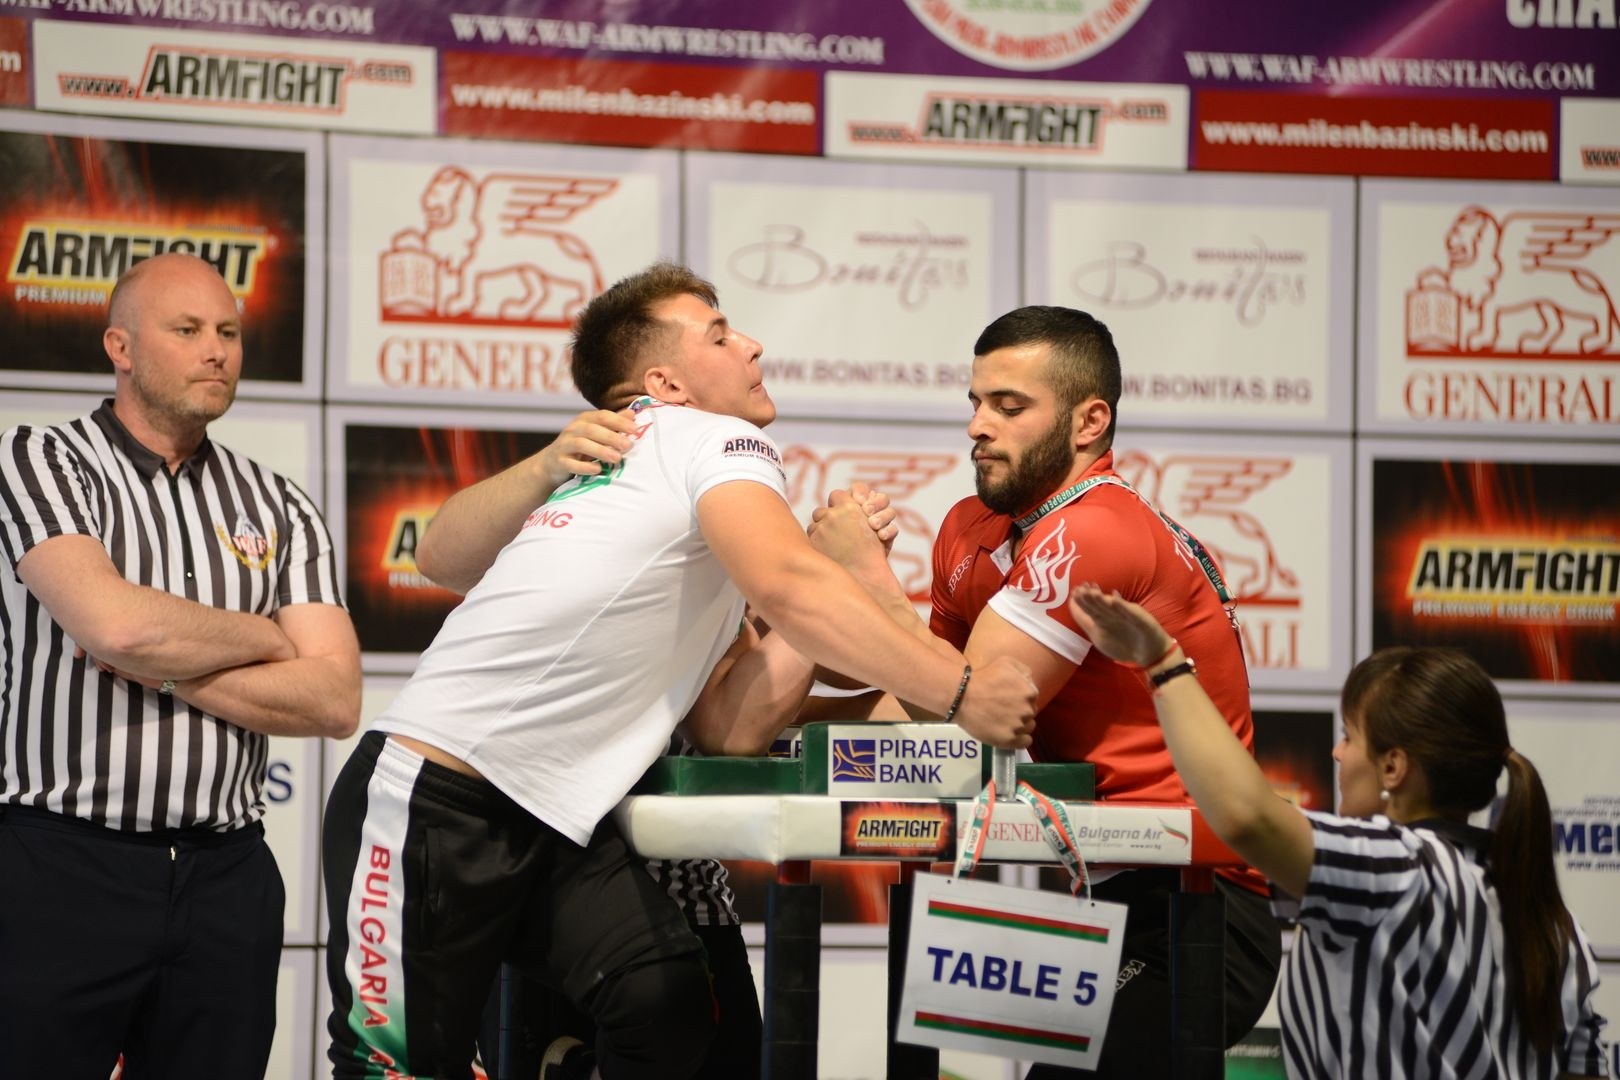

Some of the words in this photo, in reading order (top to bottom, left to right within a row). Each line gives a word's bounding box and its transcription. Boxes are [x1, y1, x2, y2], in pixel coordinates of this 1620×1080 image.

[451, 84, 815, 124] www.milenbazinski.com
[1202, 119, 1548, 153] www.milenbazinski.com
[15, 285, 106, 305] PREMIUM
[1416, 550, 1620, 592] ARMFIGHT
[879, 739, 978, 759] PIRAEUS
[879, 764, 943, 783] BANK
[857, 819, 942, 838] ARMFIGHT
[1079, 826, 1141, 842] Bulgaria
[1143, 828, 1163, 841] Air
[359, 844, 391, 1028] BULGARIA
[927, 946, 1062, 1001] TABLE
[1073, 970, 1099, 1007] 5
